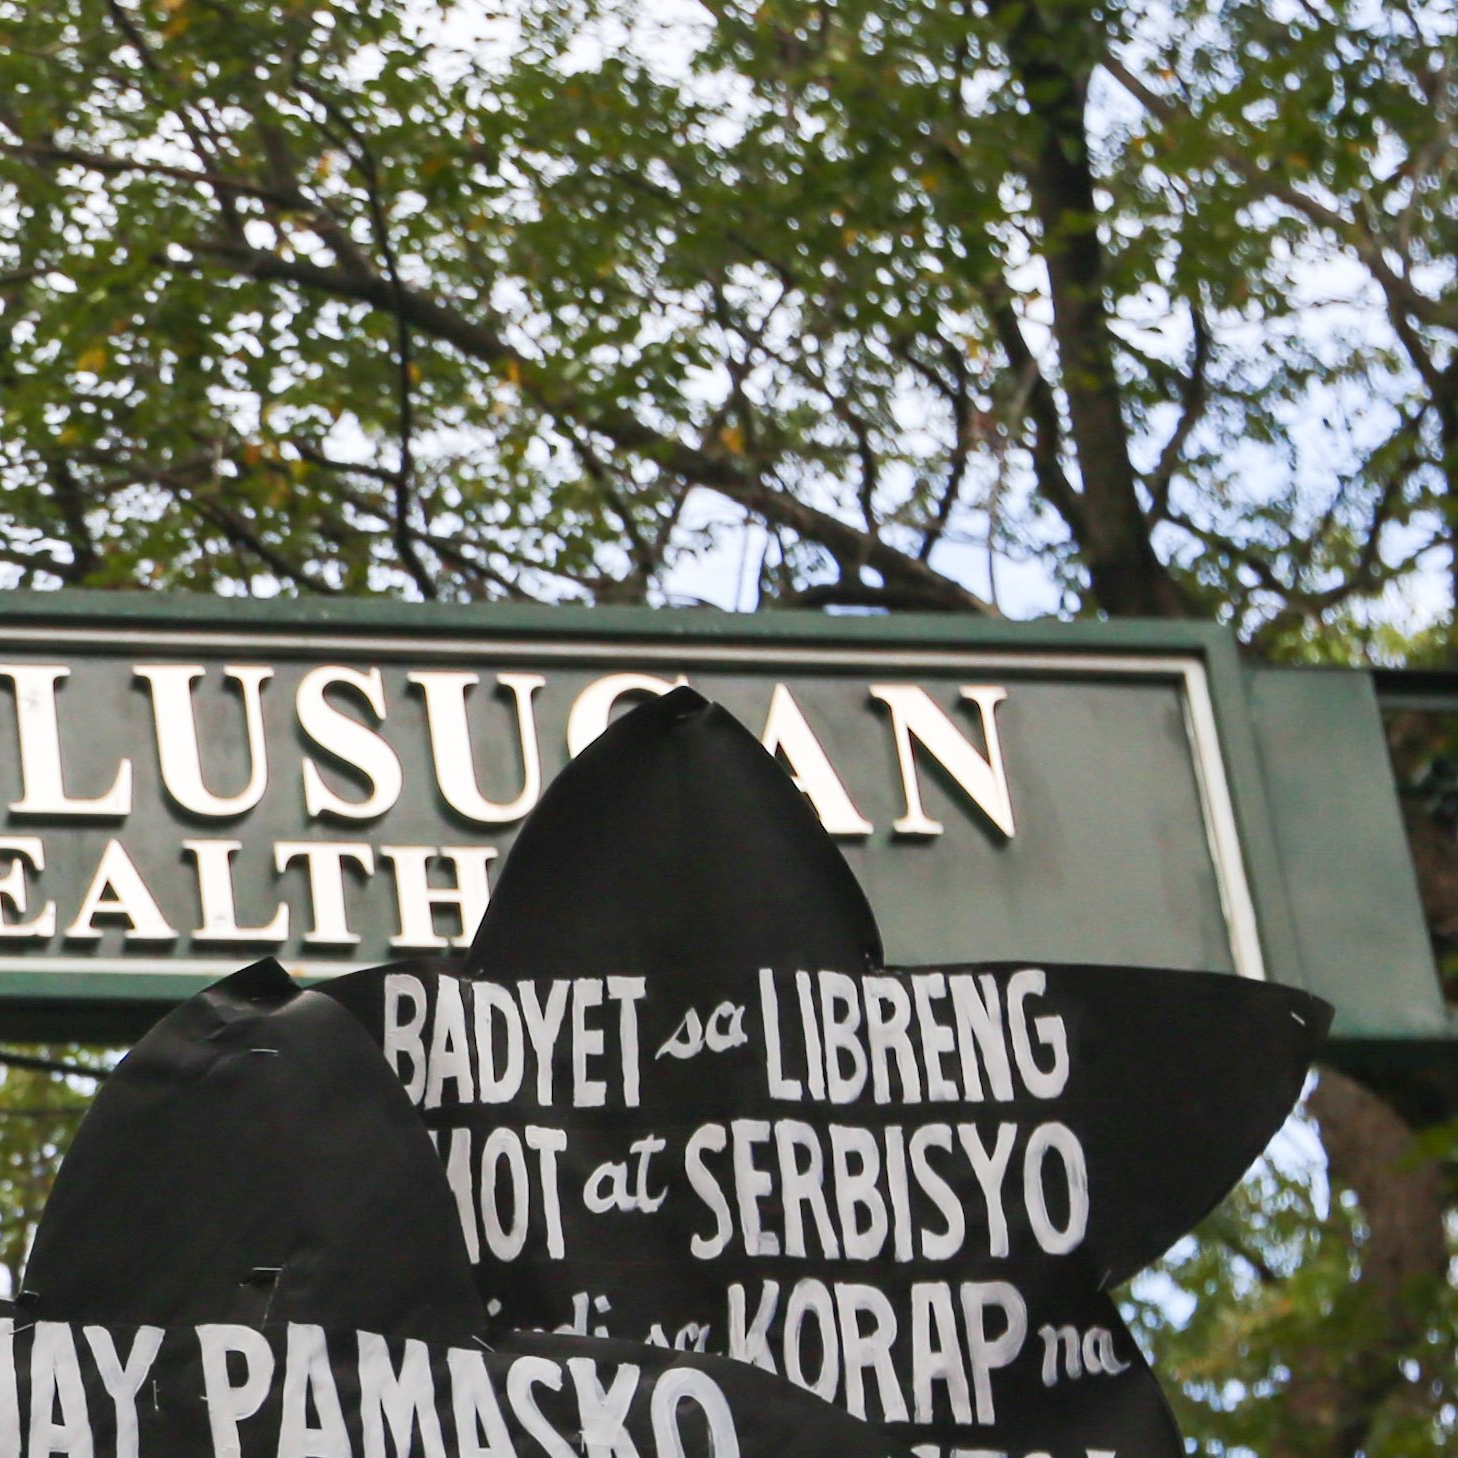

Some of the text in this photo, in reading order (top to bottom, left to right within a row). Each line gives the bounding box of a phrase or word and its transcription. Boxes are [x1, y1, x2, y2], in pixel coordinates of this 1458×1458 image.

[384, 968, 1069, 1109] BADYET sa LIBRENG
[584, 1136, 671, 1215] at
[684, 1119, 1089, 1263] SERBISYO
[727, 1279, 1027, 1425] KORAP
[1038, 1322, 1131, 1386] na
